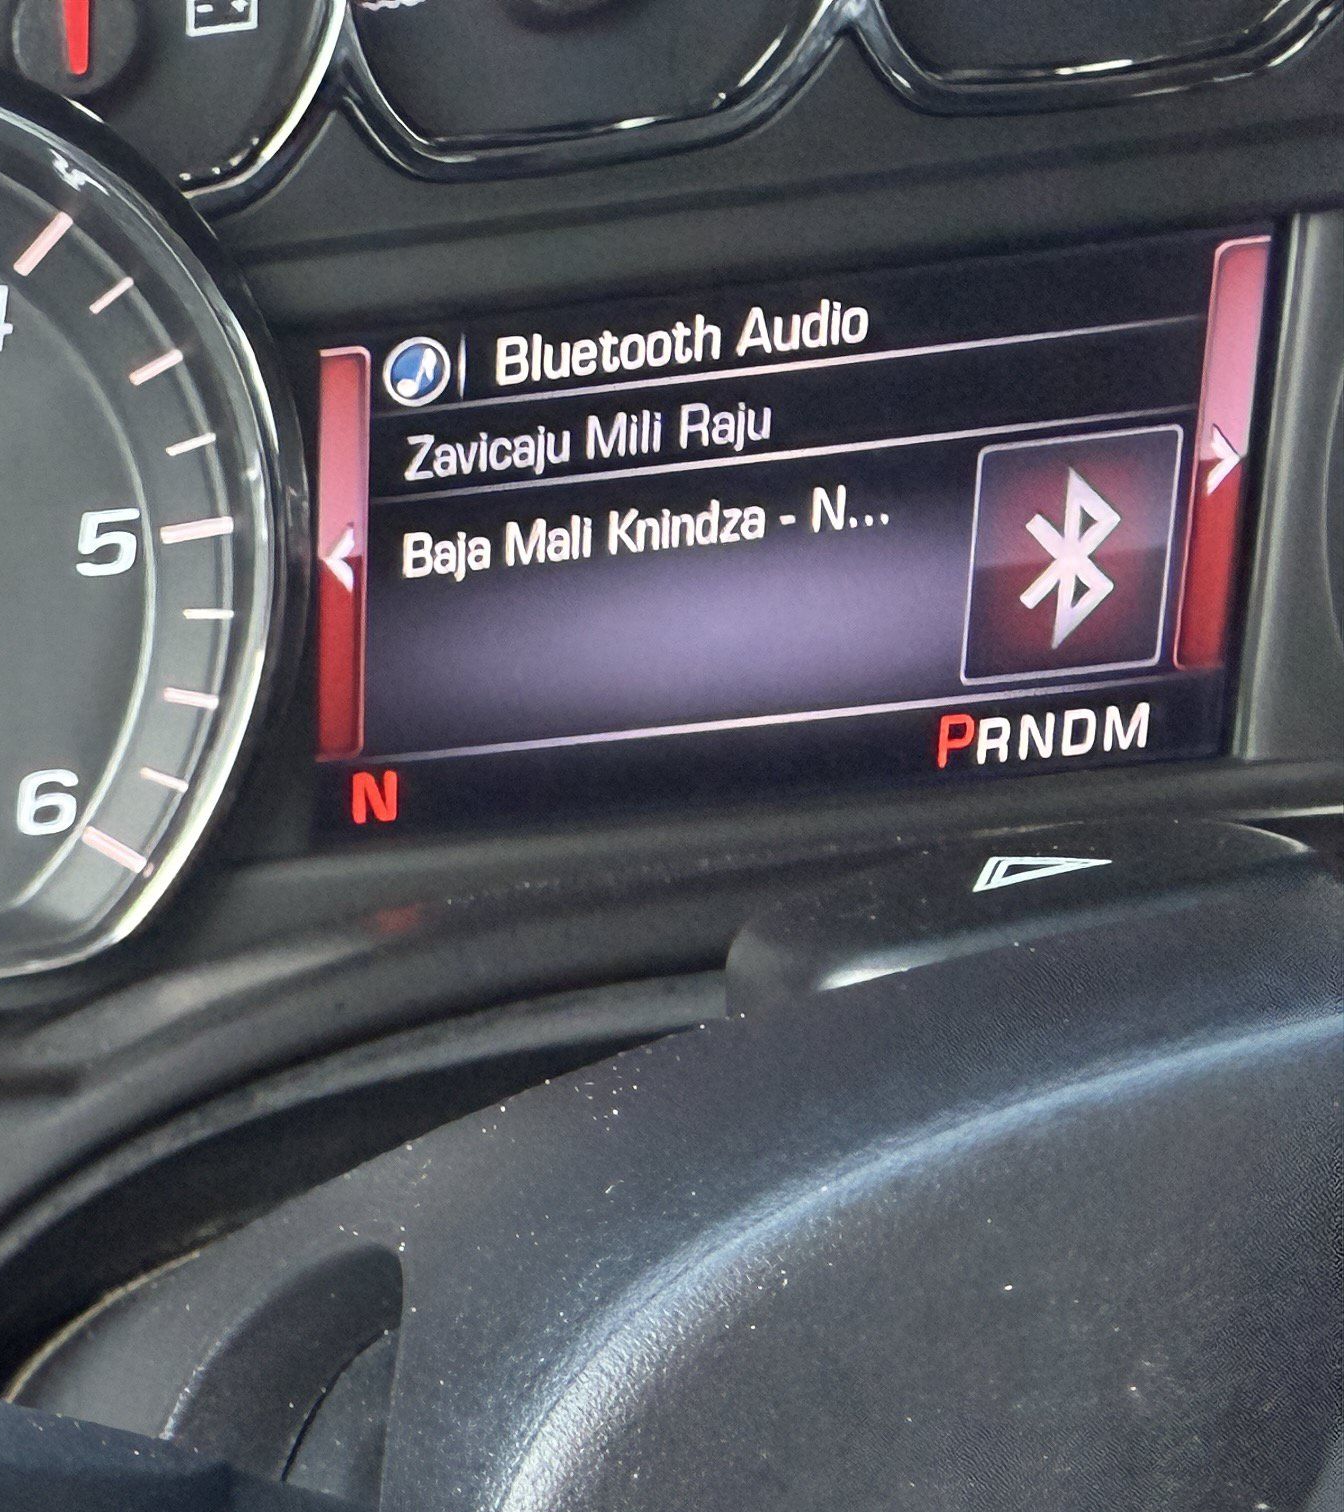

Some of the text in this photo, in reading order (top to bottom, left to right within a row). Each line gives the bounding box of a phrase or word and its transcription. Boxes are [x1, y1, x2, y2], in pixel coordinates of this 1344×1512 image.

[495, 299, 871, 389] Bluetooth Audio
[403, 400, 774, 484] Zavicaju Mili Raju
[74, 506, 142, 578] 5
[402, 530, 492, 582] Baja
[505, 518, 592, 568] Mali
[607, 499, 766, 556] Knindza
[15, 767, 79, 836] 6
[351, 770, 399, 825] N
